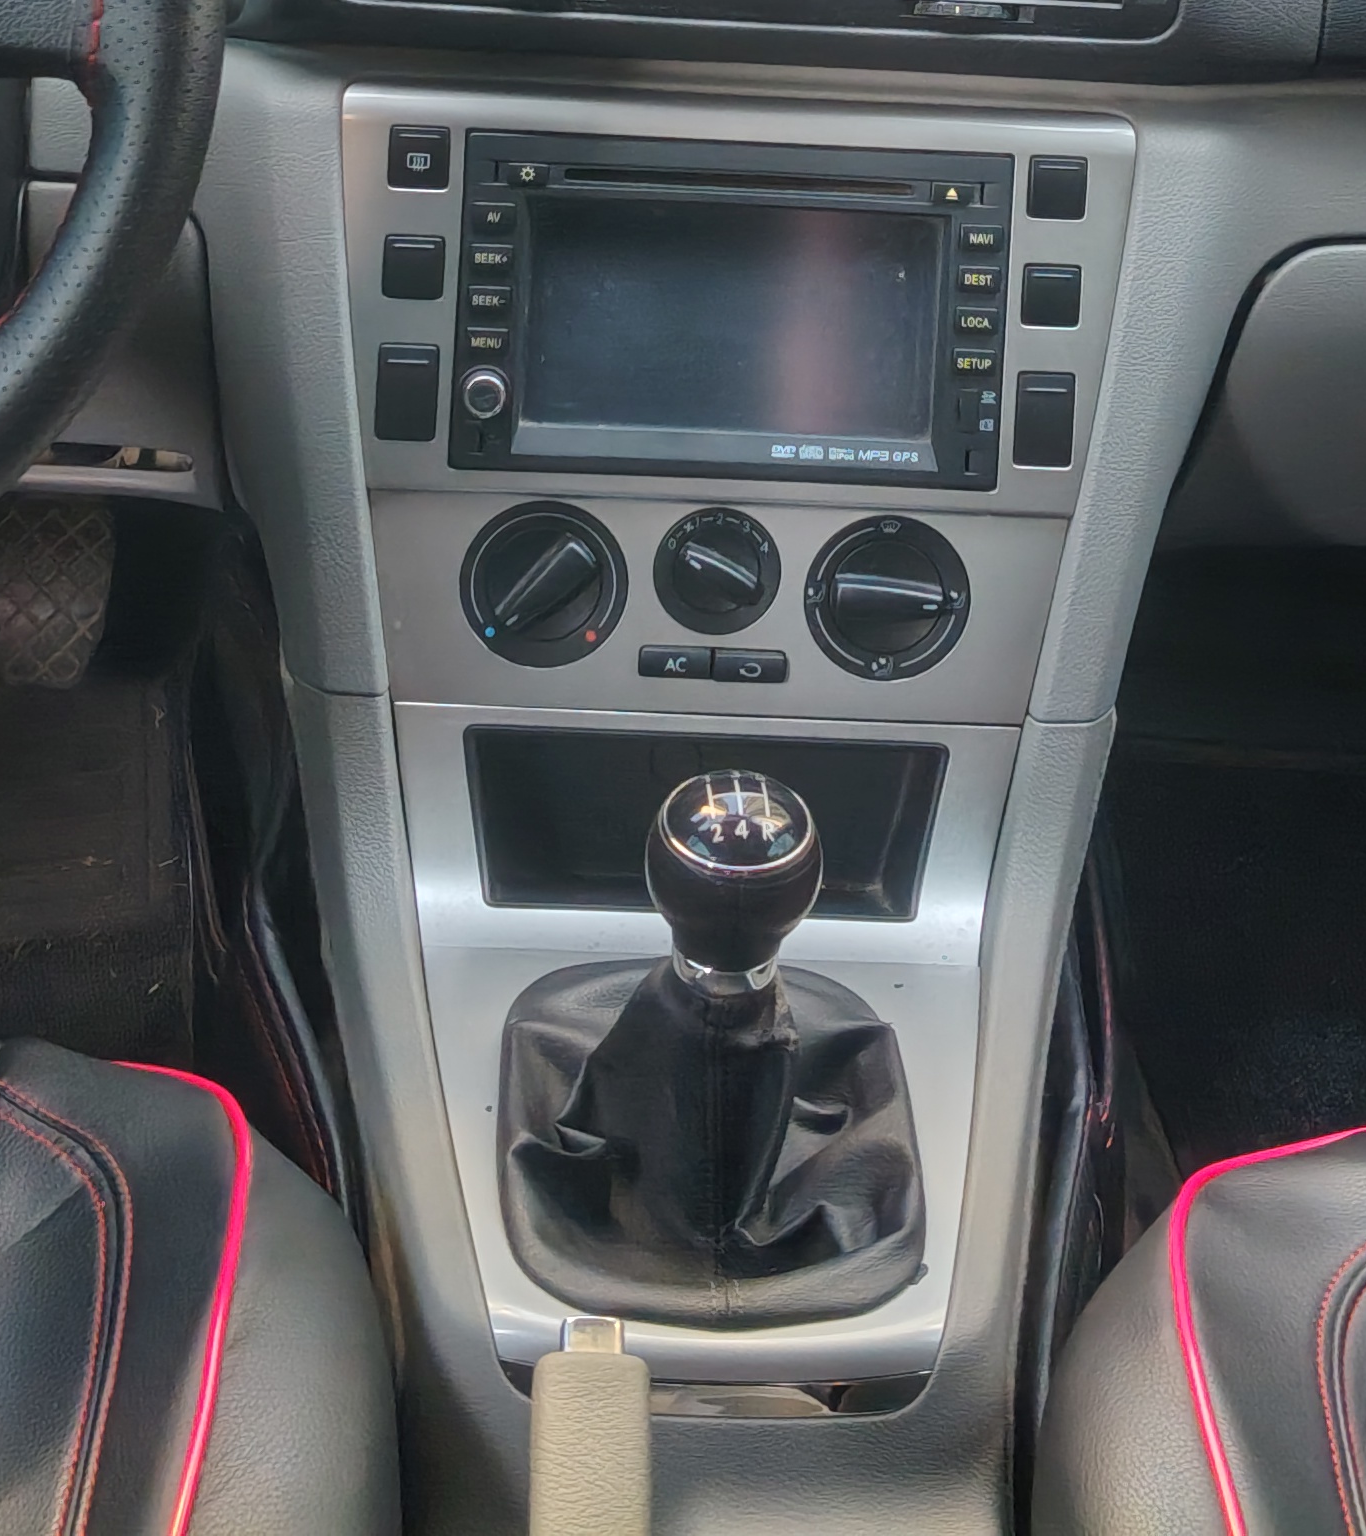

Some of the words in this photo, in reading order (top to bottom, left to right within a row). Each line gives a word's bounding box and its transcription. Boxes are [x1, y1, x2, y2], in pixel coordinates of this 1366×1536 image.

[487, 212, 501, 223] AV
[969, 233, 994, 245] NAVI
[470, 336, 502, 349] MENU
[956, 357, 992, 370] SETUP
[858, 449, 889, 462] MP3
[892, 450, 919, 463] GPS
[664, 657, 688, 673] AC
[734, 819, 750, 840] 4
[762, 821, 775, 842] R
